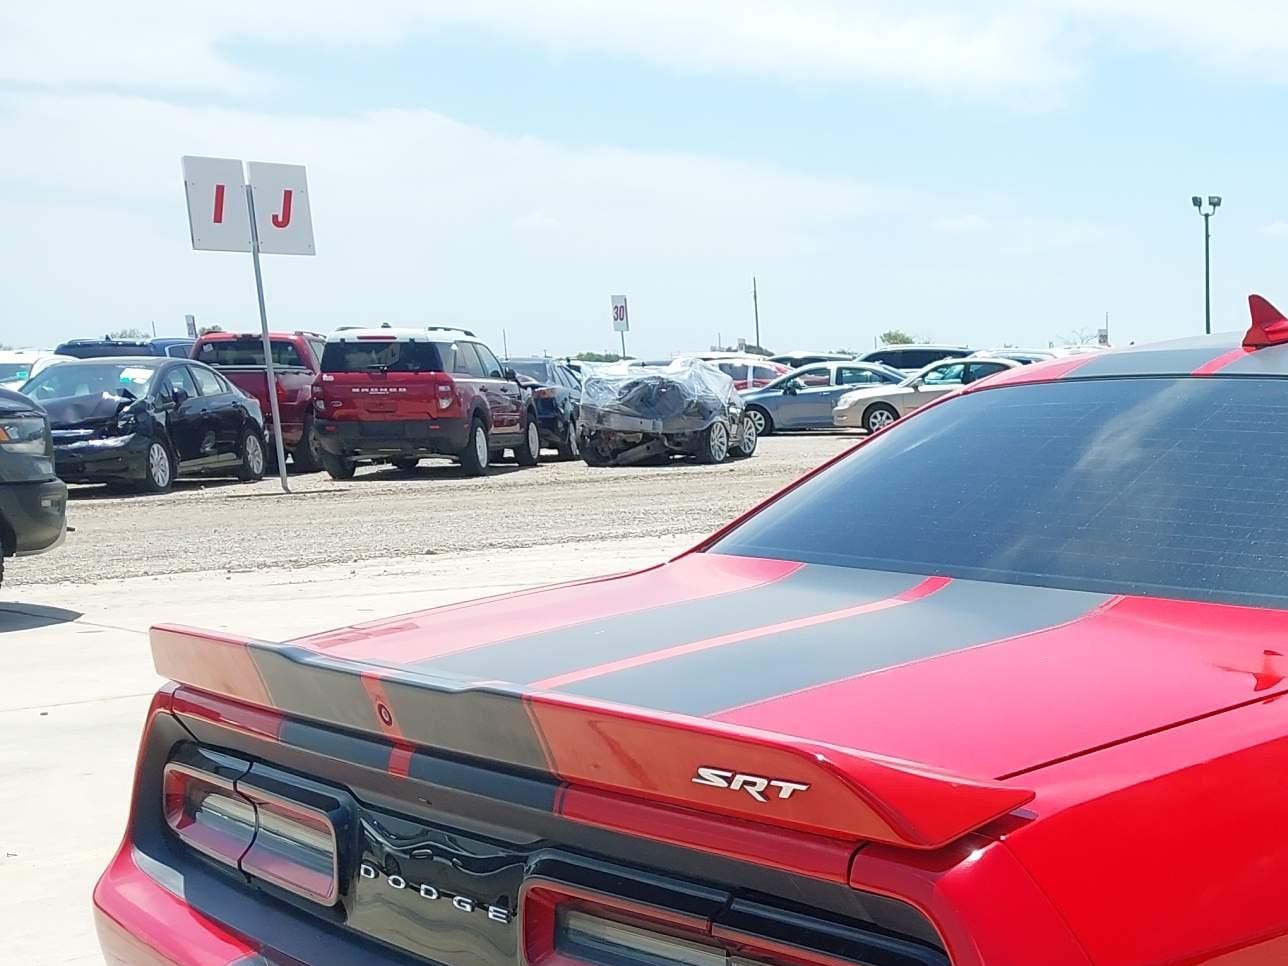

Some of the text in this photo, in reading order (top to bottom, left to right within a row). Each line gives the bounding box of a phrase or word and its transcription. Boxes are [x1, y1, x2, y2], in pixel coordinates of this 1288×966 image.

[213, 184, 225, 224] I
[271, 189, 293, 228] J
[613, 304, 625, 321] 30
[691, 767, 810, 803] SRT
[360, 863, 511, 924] DODGE
